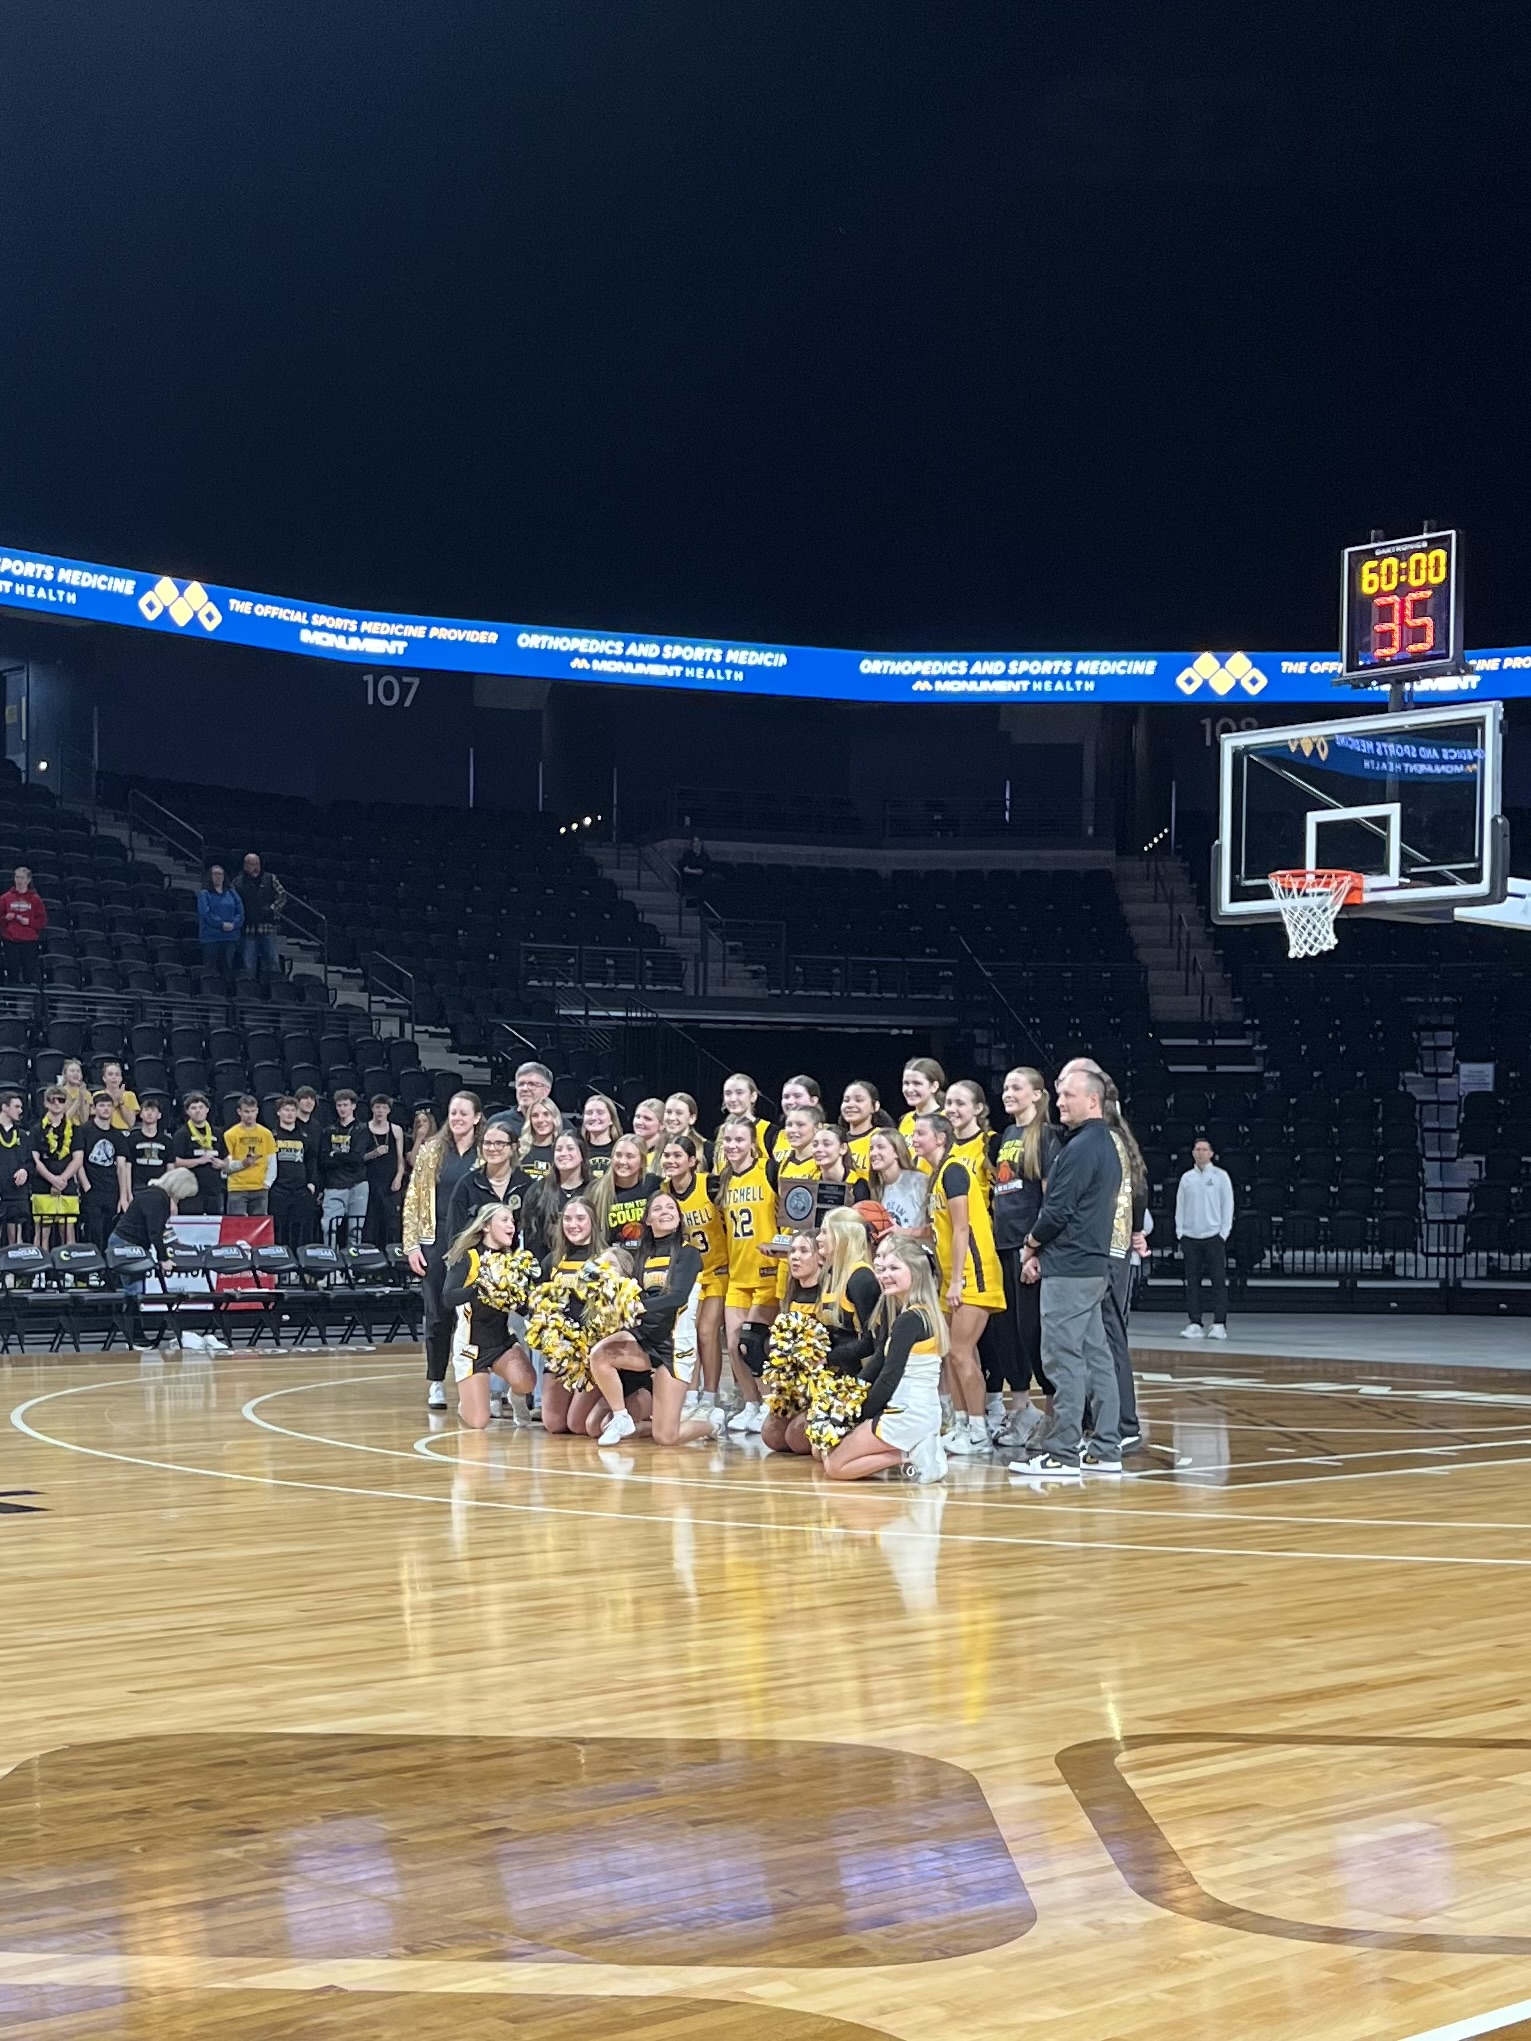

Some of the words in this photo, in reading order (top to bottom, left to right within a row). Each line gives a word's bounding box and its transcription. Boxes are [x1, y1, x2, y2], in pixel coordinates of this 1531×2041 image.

[0, 556, 55, 582] PORTS
[57, 567, 137, 596] MEDICINE
[1361, 548, 1448, 595] 60:00
[15, 582, 77, 605] HEALTH
[229, 598, 254, 615] THE
[254, 604, 309, 625] OFFICIAL
[311, 613, 358, 633] SPORTS
[360, 620, 427, 639] MEDICINE
[429, 626, 499, 645] PROVIDER
[1373, 589, 1434, 659] 35
[300, 627, 409, 655] MONUMENT
[517, 633, 625, 655] ORTHOPEDICS
[625, 642, 660, 658] AND
[662, 644, 723, 663] SPORTS
[592, 658, 685, 678] MONUMENT
[685, 667, 744, 682] HEALTH
[859, 658, 969, 675] ORTHOPEDICS
[969, 660, 1006, 675] AND
[1007, 659, 1073, 675] SPORTS
[1075, 659, 1158, 675] MEDICINE
[1280, 661, 1309, 674] THE
[1502, 656, 1531, 670] PRO
[362, 673, 420, 708] 107
[934, 679, 1031, 692] MONUMENT
[1032, 679, 1096, 692] HEALTH
[723, 1185, 765, 1206] ITCHELL
[608, 1207, 646, 1228] COUR
[684, 1207, 713, 1227] HELL
[730, 1208, 755, 1239] 12
